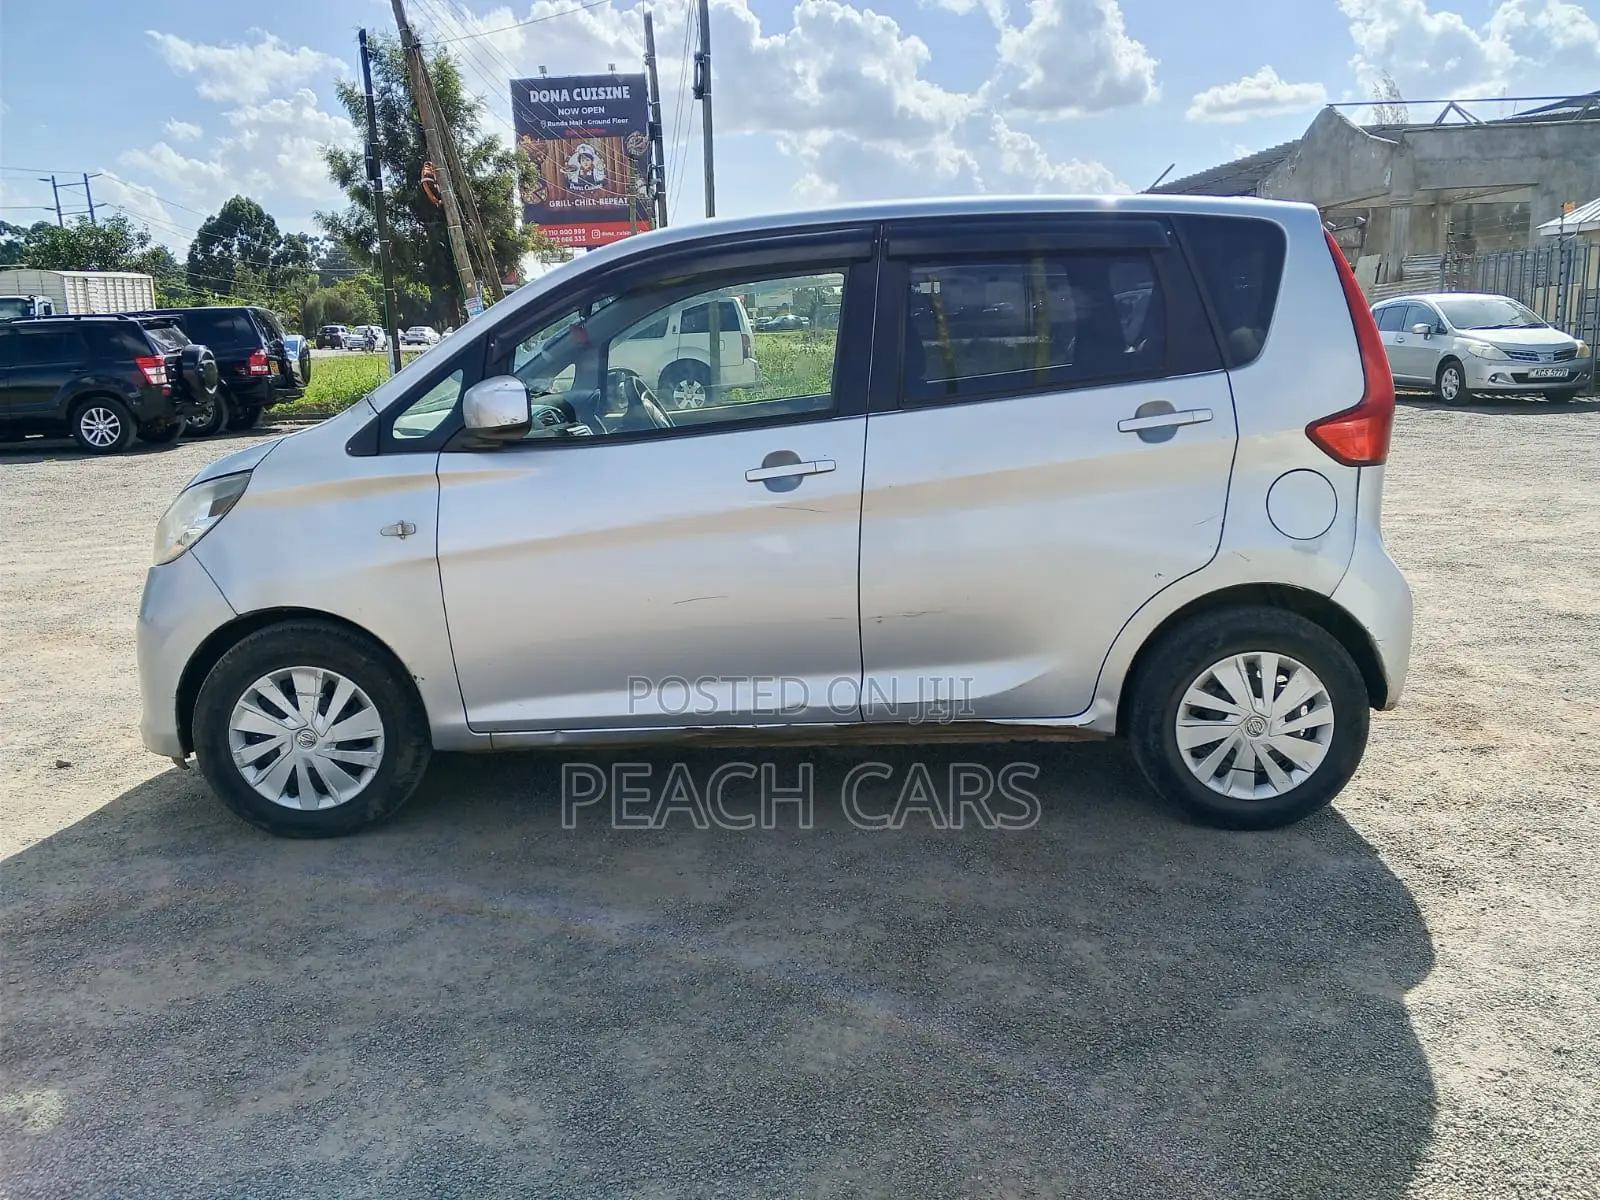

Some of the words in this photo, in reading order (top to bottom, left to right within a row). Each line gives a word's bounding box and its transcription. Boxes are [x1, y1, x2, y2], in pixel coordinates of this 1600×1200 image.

[529, 89, 570, 103] DONA
[573, 86, 630, 100] CUISINE
[558, 107, 579, 115] NOW
[581, 106, 605, 114] OPEN
